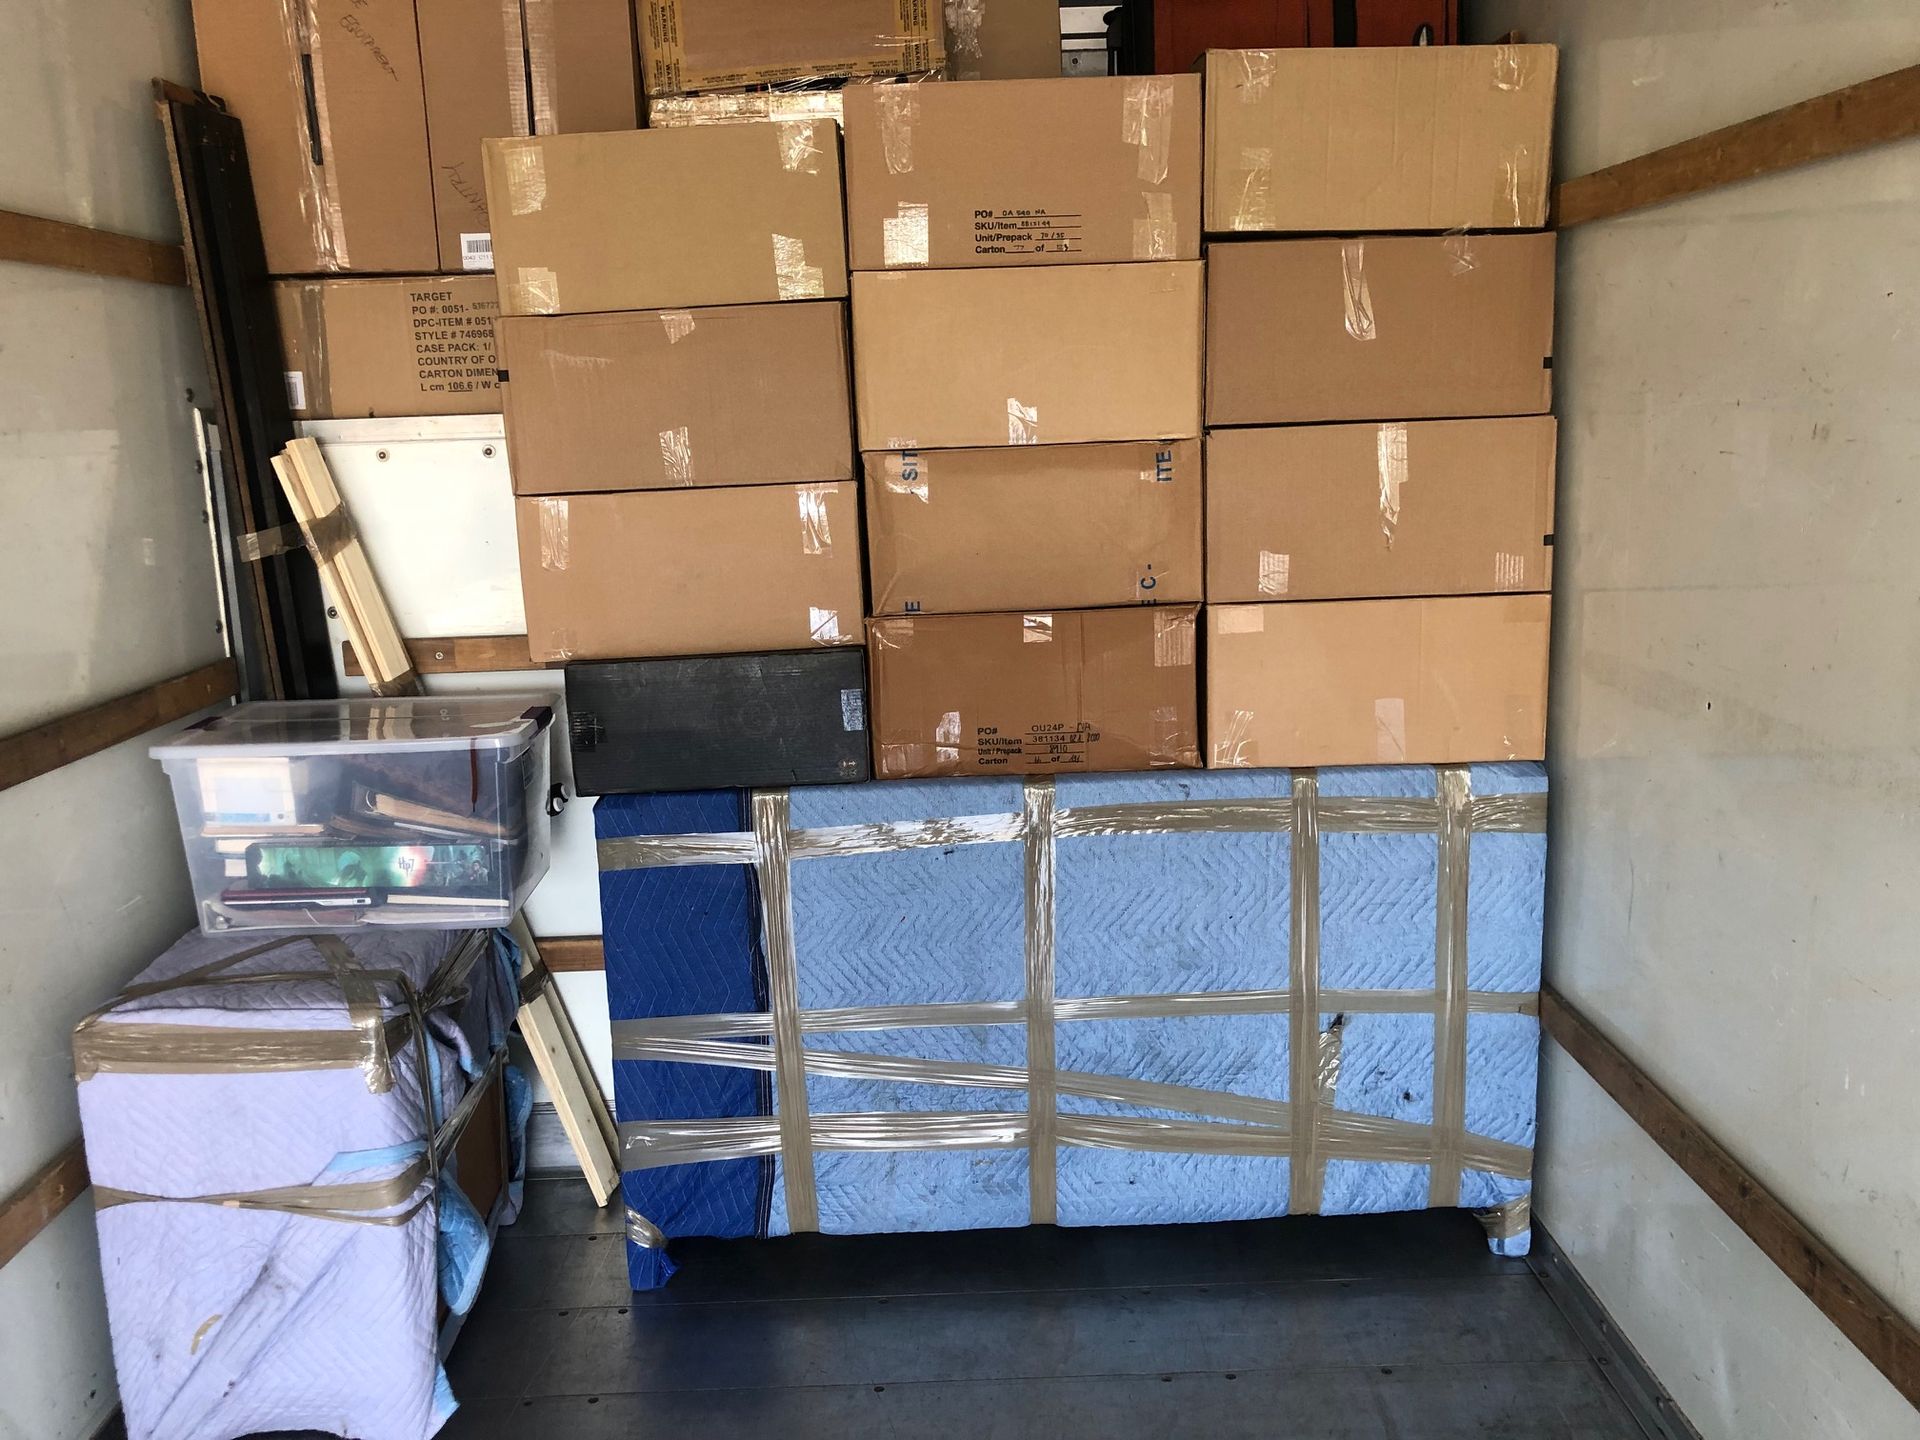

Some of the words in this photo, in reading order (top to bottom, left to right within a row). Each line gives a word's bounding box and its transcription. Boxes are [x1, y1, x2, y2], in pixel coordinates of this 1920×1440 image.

[660, 6, 669, 43] WARNING
[974, 210, 993, 219] PO#
[974, 222, 1017, 230] SKU/Item
[975, 233, 1033, 242] Unit/Prepack
[975, 245, 1006, 254] Carton
[1035, 244, 1045, 252] of
[410, 292, 452, 302] TARGET
[412, 306, 427, 315] PO
[413, 318, 464, 328] DPC-ITEM
[466, 317, 473, 325] #
[415, 331, 449, 341] STYLE
[450, 331, 457, 339] #
[416, 344, 446, 353] CASE
[448, 343, 480, 352] PACK:
[417, 356, 468, 366] COUNTRY
[470, 355, 485, 364] OF
[419, 369, 463, 379] CARTON
[466, 368, 498, 377] DIMEN
[420, 383, 427, 391] L
[429, 383, 445, 391] cm
[448, 381, 473, 391] 106.6
[481, 381, 491, 389] W
[1156, 450, 1172, 482] ITE
[977, 727, 998, 735] PO#
[978, 738, 1022, 746] SKU/Item
[978, 757, 1008, 765] Carton
[1051, 755, 1060, 763] of
